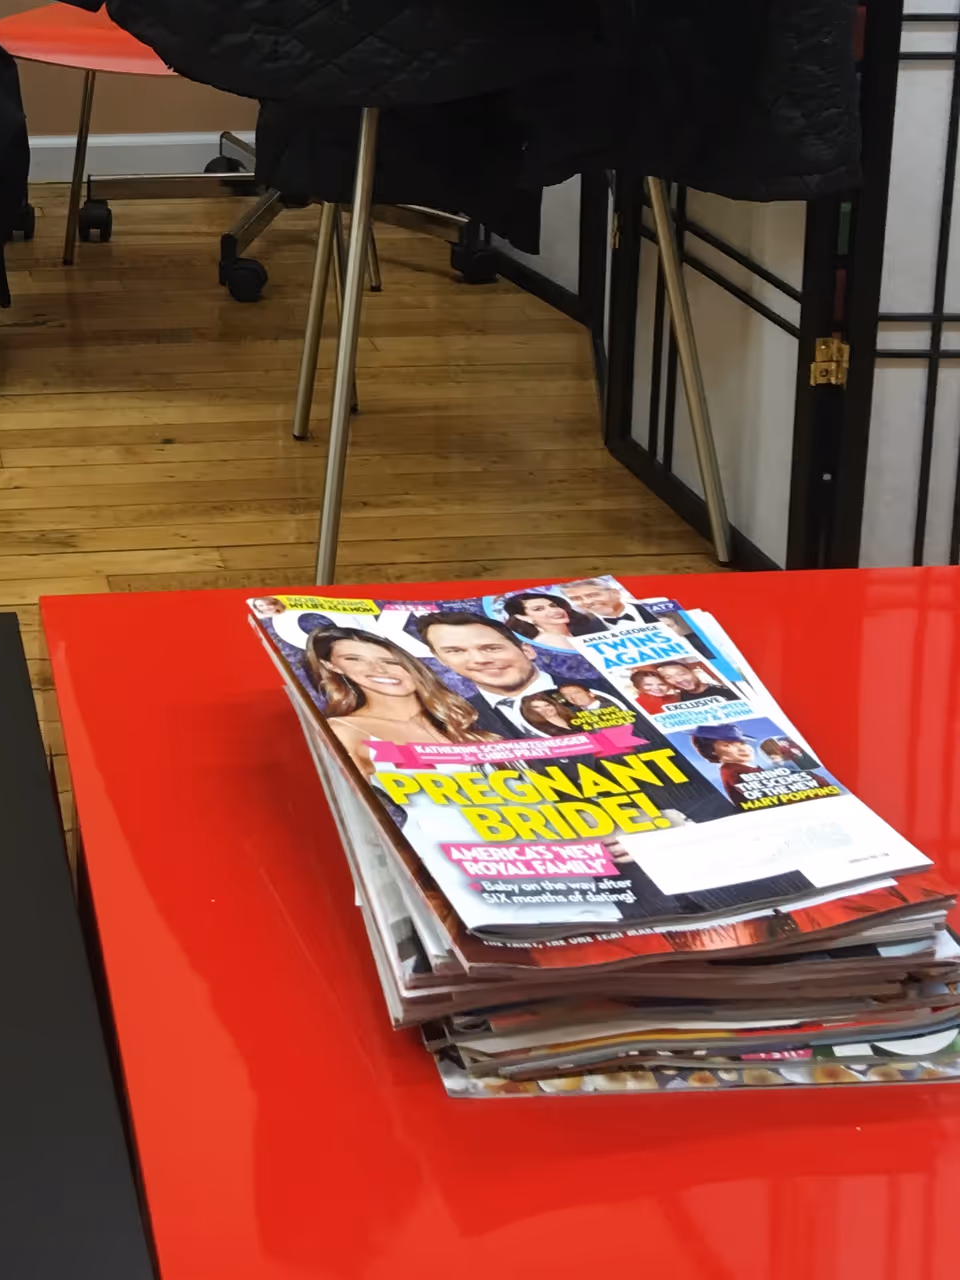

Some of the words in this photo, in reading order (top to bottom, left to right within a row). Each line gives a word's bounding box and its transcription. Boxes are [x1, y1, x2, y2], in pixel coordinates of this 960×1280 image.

[582, 632, 610, 644] AMAL
[619, 625, 660, 636] GEORGE
[586, 631, 673, 656] TWINS
[603, 642, 690, 669] AGAIN!
[666, 697, 722, 711] EXCLUSIVE
[414, 743, 480, 754] KATHERINE
[481, 735, 590, 754] SCHWARZENEGGER
[478, 750, 515, 761] CHRIS
[514, 748, 553, 758] PRATT
[374, 748, 690, 806] PREGNANT
[734, 781, 763, 791] THE
[762, 771, 813, 787] SCENES
[739, 767, 791, 781] BEHIND
[741, 796, 779, 810] MARY
[779, 785, 842, 803] POPPINS!
[743, 789, 763, 800] OF
[763, 785, 789, 797] THE
[789, 779, 820, 792] NEW
[460, 793, 672, 842] BRIDE!
[450, 845, 554, 861] AMERICA'S
[461, 860, 531, 876] ROYAL
[534, 858, 608, 875] FAMILY'
[481, 880, 520, 894] Baby
[521, 883, 540, 891] on
[540, 880, 567, 891] the
[568, 881, 597, 893] way
[598, 879, 632, 890] after
[482, 893, 511, 904] SIX
[512, 892, 568, 904] months
[569, 891, 584, 903] of
[585, 889, 637, 904] dating!
